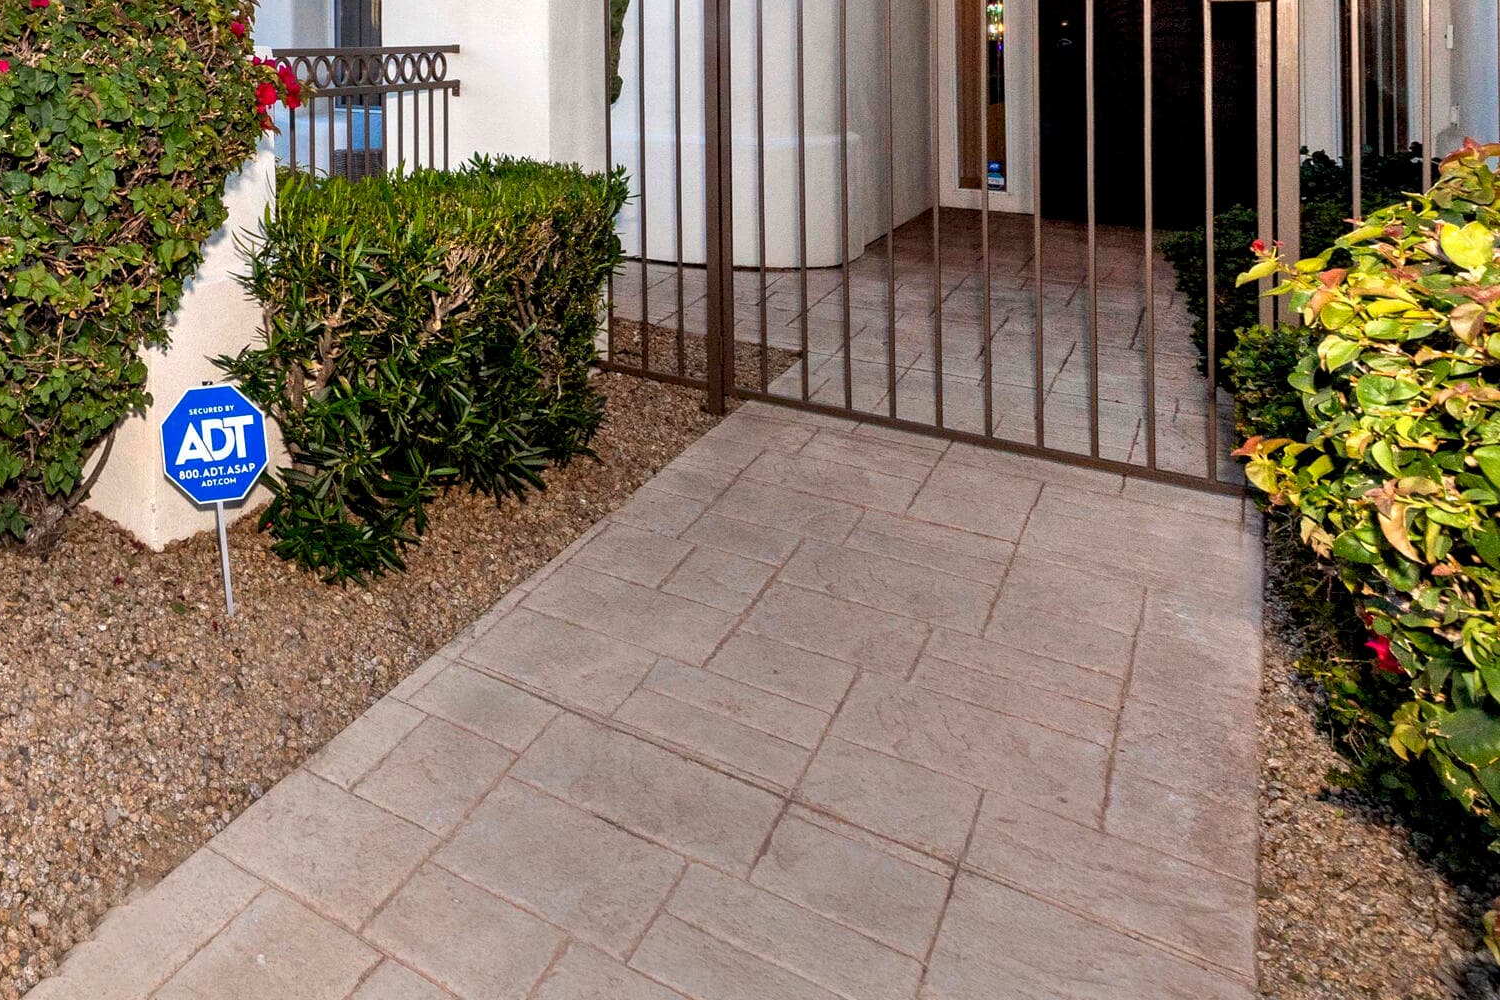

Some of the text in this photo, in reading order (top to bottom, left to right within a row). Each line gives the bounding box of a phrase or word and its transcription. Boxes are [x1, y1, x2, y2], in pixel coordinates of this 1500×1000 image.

[189, 406, 223, 415] SECURED
[175, 415, 254, 465] ADT
[179, 463, 256, 480] 800.ADT.ASAP
[202, 478, 236, 487] ADT.COM
